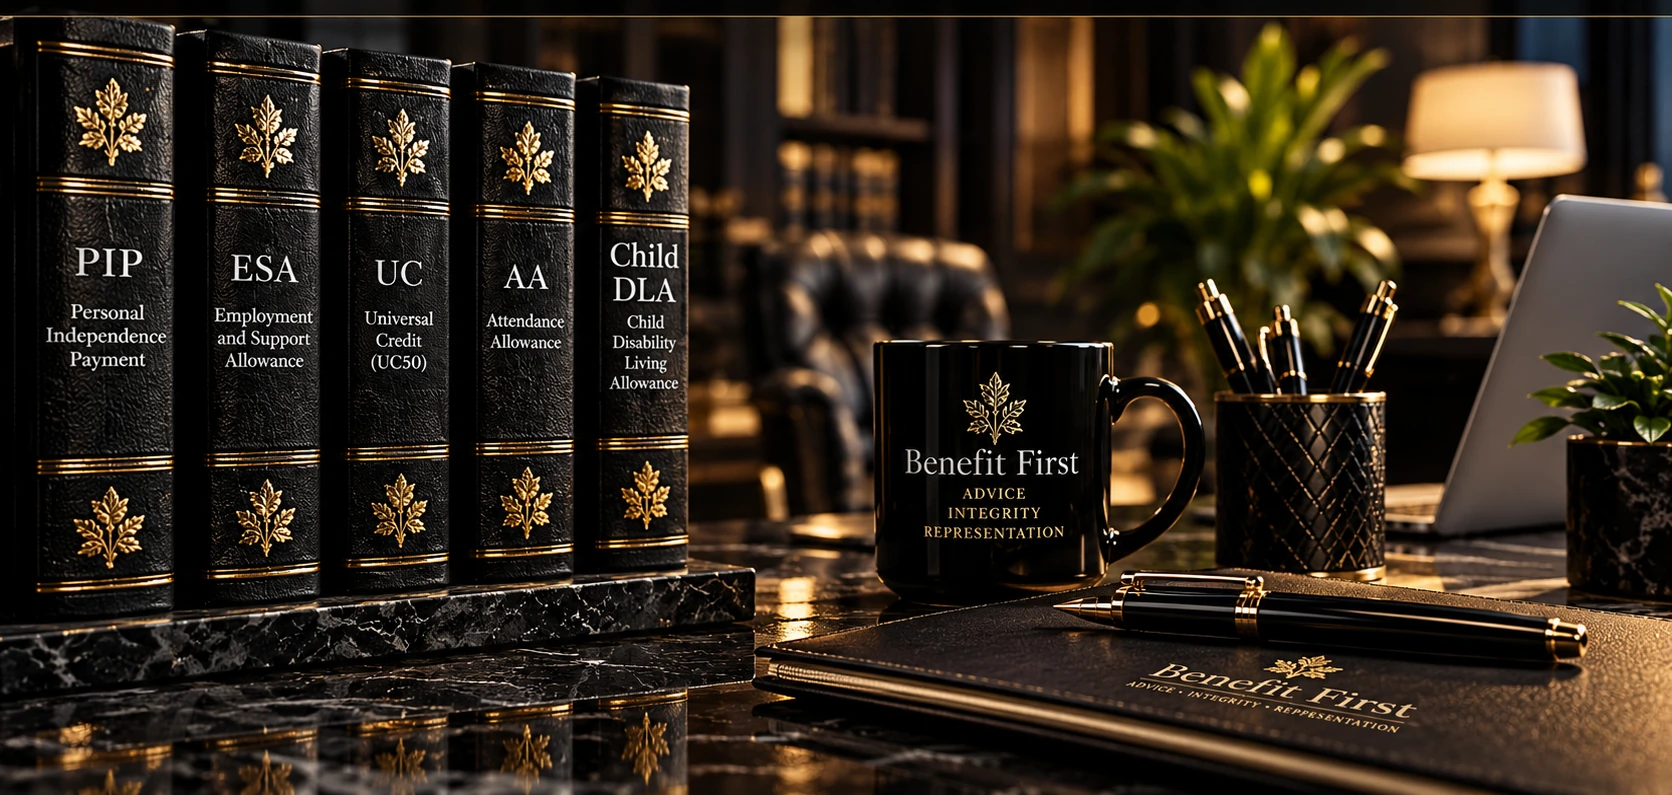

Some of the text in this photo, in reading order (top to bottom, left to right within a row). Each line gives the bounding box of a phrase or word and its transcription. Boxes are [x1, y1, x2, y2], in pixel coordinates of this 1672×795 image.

[75, 247, 143, 278] PIP
[610, 241, 680, 269] Child
[231, 254, 299, 283] ESA
[375, 259, 423, 287] UC
[503, 264, 549, 290] AA
[613, 276, 677, 303] DLA
[70, 303, 145, 321] Personal
[214, 307, 314, 328] Employment
[364, 310, 434, 326] Universal
[486, 313, 565, 329] Attendance
[627, 314, 665, 330] Child
[46, 326, 167, 348] Independence
[217, 330, 311, 350] and Support
[375, 332, 422, 348] Credit
[490, 333, 562, 350] Allowance
[612, 334, 677, 354] Disability
[70, 351, 146, 371] Payment
[224, 352, 304, 368] Allowance
[371, 354, 427, 373] (UC50)
[624, 355, 668, 374] Living
[609, 375, 679, 390] Allowance
[904, 448, 1079, 476] Benefit First
[962, 487, 1026, 500] ADVICE
[948, 507, 1041, 519] INTEGRITY
[924, 525, 1064, 539] REPRESENTATION
[1126, 680, 1177, 694] ADVICE
[1187, 690, 1261, 708] INTEGRITY
[1148, 662, 1418, 719] Benefit First
